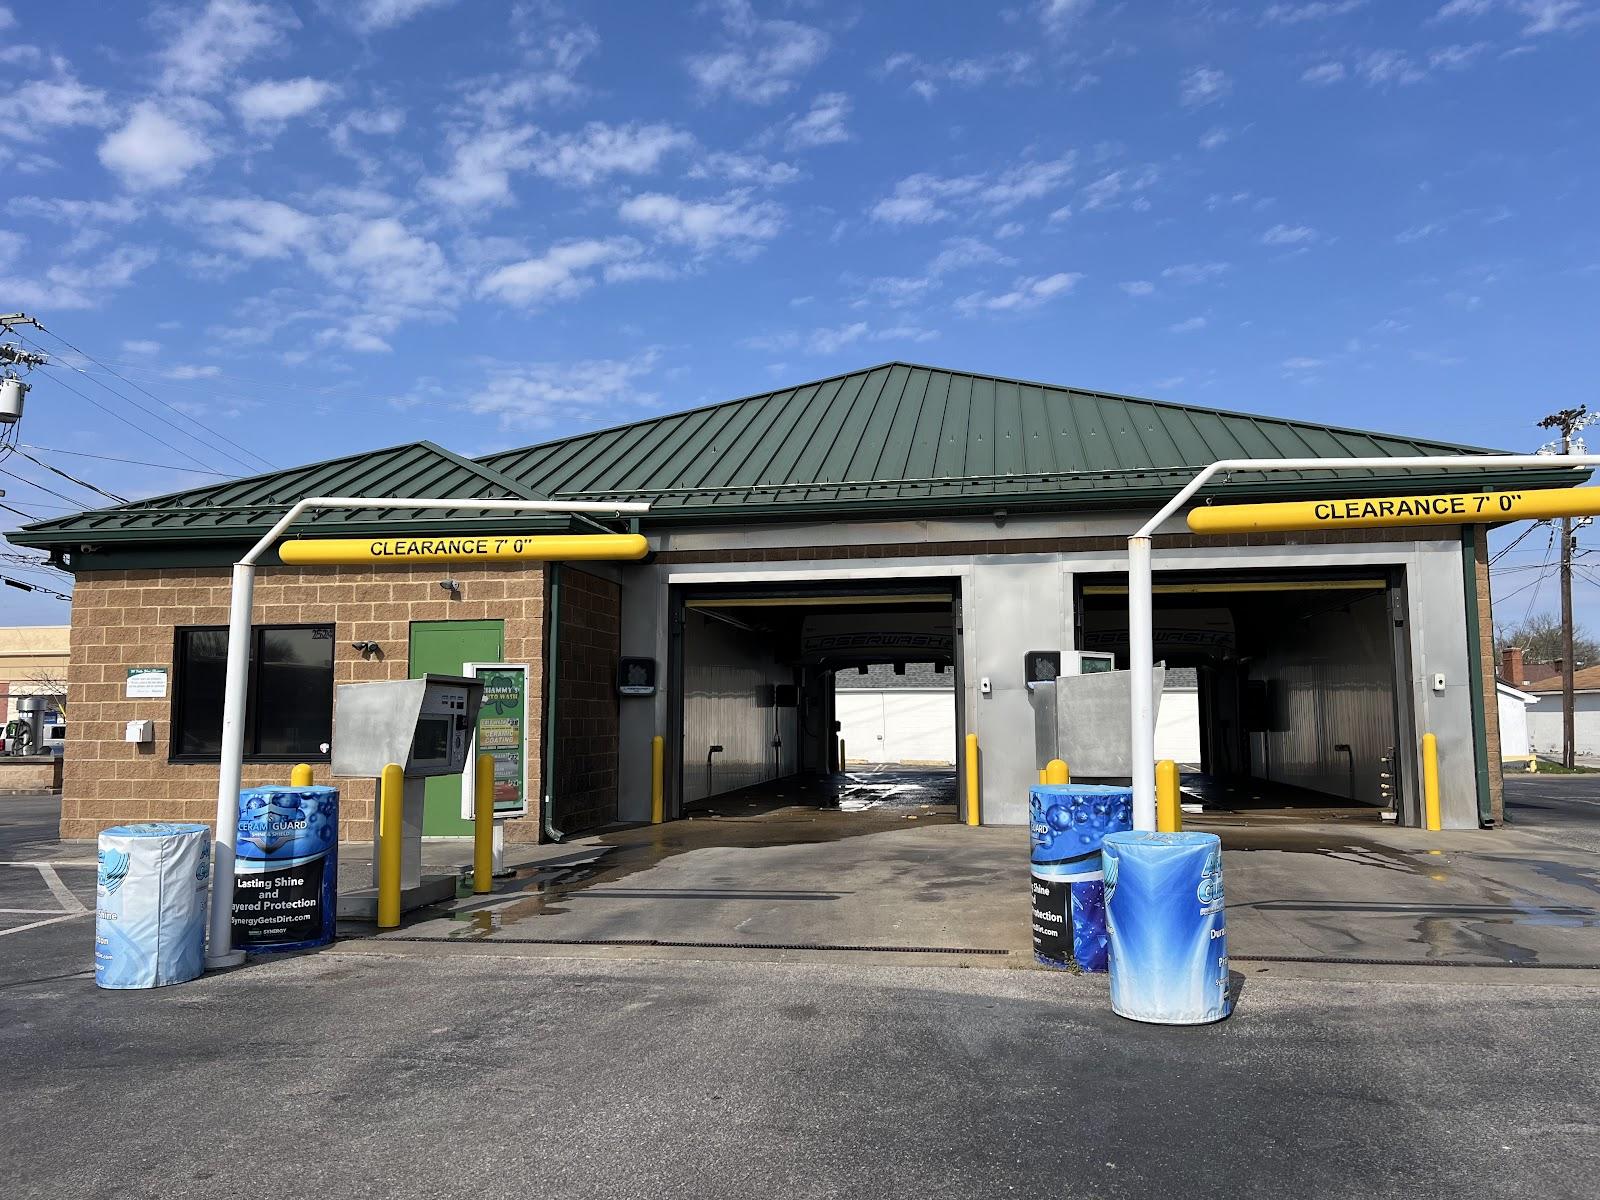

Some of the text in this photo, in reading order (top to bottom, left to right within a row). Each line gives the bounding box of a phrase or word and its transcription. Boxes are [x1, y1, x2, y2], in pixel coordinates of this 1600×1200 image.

[1314, 494, 1522, 520] CLEARANCE 7' 0"
[370, 538, 532, 555] CLEARANCE 7' 0"
[237, 876, 305, 889] Lasting Shine
[1033, 882, 1050, 896] Shine
[258, 889, 279, 899] and
[231, 898, 317, 913] ayered Protection
